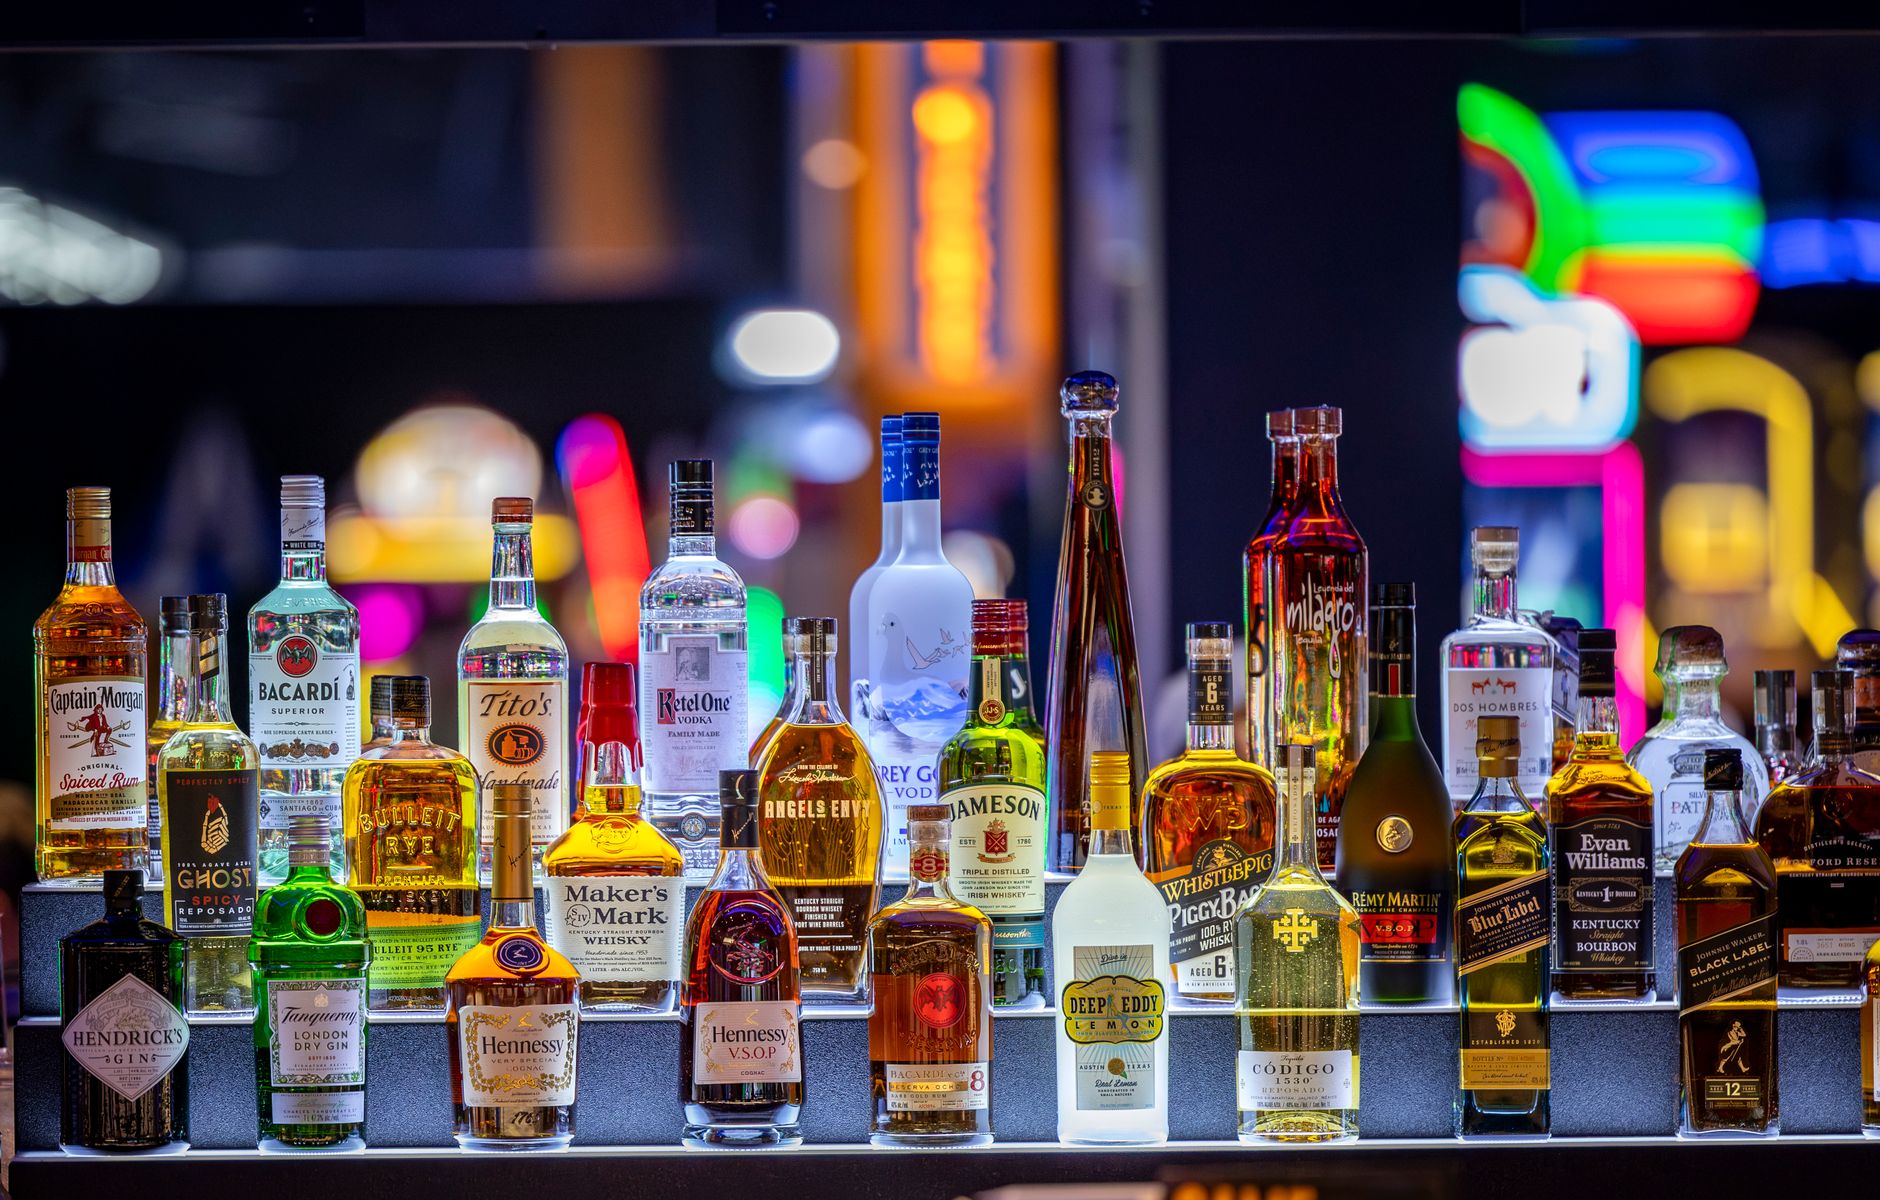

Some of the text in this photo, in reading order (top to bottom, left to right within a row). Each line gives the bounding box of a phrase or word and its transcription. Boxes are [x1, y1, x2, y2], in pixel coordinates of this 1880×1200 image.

[1313, 582, 1354, 597] Leyenda del
[1286, 571, 1353, 679] milagro
[1293, 634, 1323, 650] Tequila
[259, 676, 339, 700] BACARDÍ
[1207, 682, 1218, 704] 6
[51, 686, 143, 715] Captain Morgan
[480, 689, 552, 717] Tito's
[658, 691, 730, 721] Ketel One
[1453, 702, 1537, 712] DOS HOMBRES
[678, 716, 712, 724] VODKA
[81, 763, 119, 771] ORIGINAL
[60, 773, 140, 791] Spiced Rum
[765, 800, 871, 818] ANGELS ENVY
[950, 795, 1040, 822] JAMESON
[360, 806, 461, 833] BULLEIT
[386, 836, 434, 856] RYE
[1580, 834, 1631, 851] Evan
[1803, 839, 1870, 851] DISTILLER'S SELECT
[922, 858, 936, 873] 8
[1565, 852, 1646, 870] Williams
[178, 869, 251, 889] GHOST
[375, 875, 444, 886] FRONTIER
[1162, 853, 1272, 903] WHISTLEPIG
[192, 895, 241, 906] SPICY
[564, 885, 668, 902] Maker's
[1352, 891, 1438, 907] RÉMY MARTIN
[179, 905, 252, 915] REPOSADO
[1474, 889, 1531, 915] JOHNNIE WALKER
[571, 907, 668, 925] S Mark
[1467, 896, 1540, 936] Blue Label
[1572, 919, 1640, 929] KENTUCKY
[1375, 924, 1414, 933] V.S.O.P
[1501, 922, 1521, 931] SCOTCH
[583, 936, 651, 944] WHISKY
[1589, 930, 1624, 941] Straight
[416, 943, 458, 953] 95 RYE
[1576, 942, 1636, 952] BOURBON
[1697, 932, 1763, 963] JOHNNIE WALKER
[1190, 955, 1226, 978] AGED 6
[1590, 953, 1626, 964] Whiskey
[1689, 941, 1772, 977] BLACK LABEL
[1692, 955, 1770, 987] BLENDED SCOTCH WHISKY
[1070, 995, 1158, 1014] DEEP EDDY
[281, 1006, 357, 1026] Tanqueray
[1075, 1020, 1155, 1030] LEMON
[73, 1028, 183, 1046] HENDRICK'S
[294, 1030, 348, 1040] LONDON
[712, 1026, 788, 1046] Hennessy
[295, 1041, 348, 1051] DRY GIN
[482, 1036, 564, 1056] Hennessy
[728, 1046, 776, 1059] V.S.O.P
[114, 1053, 148, 1064] GIN
[1280, 1054, 1304, 1064] Tequila
[1252, 1061, 1334, 1075] CÓDIGO
[970, 1070, 985, 1092] 8
[1114, 1079, 1138, 1087] Lemon
[1275, 1077, 1310, 1085] 1530
[1725, 1083, 1741, 1096] 12
